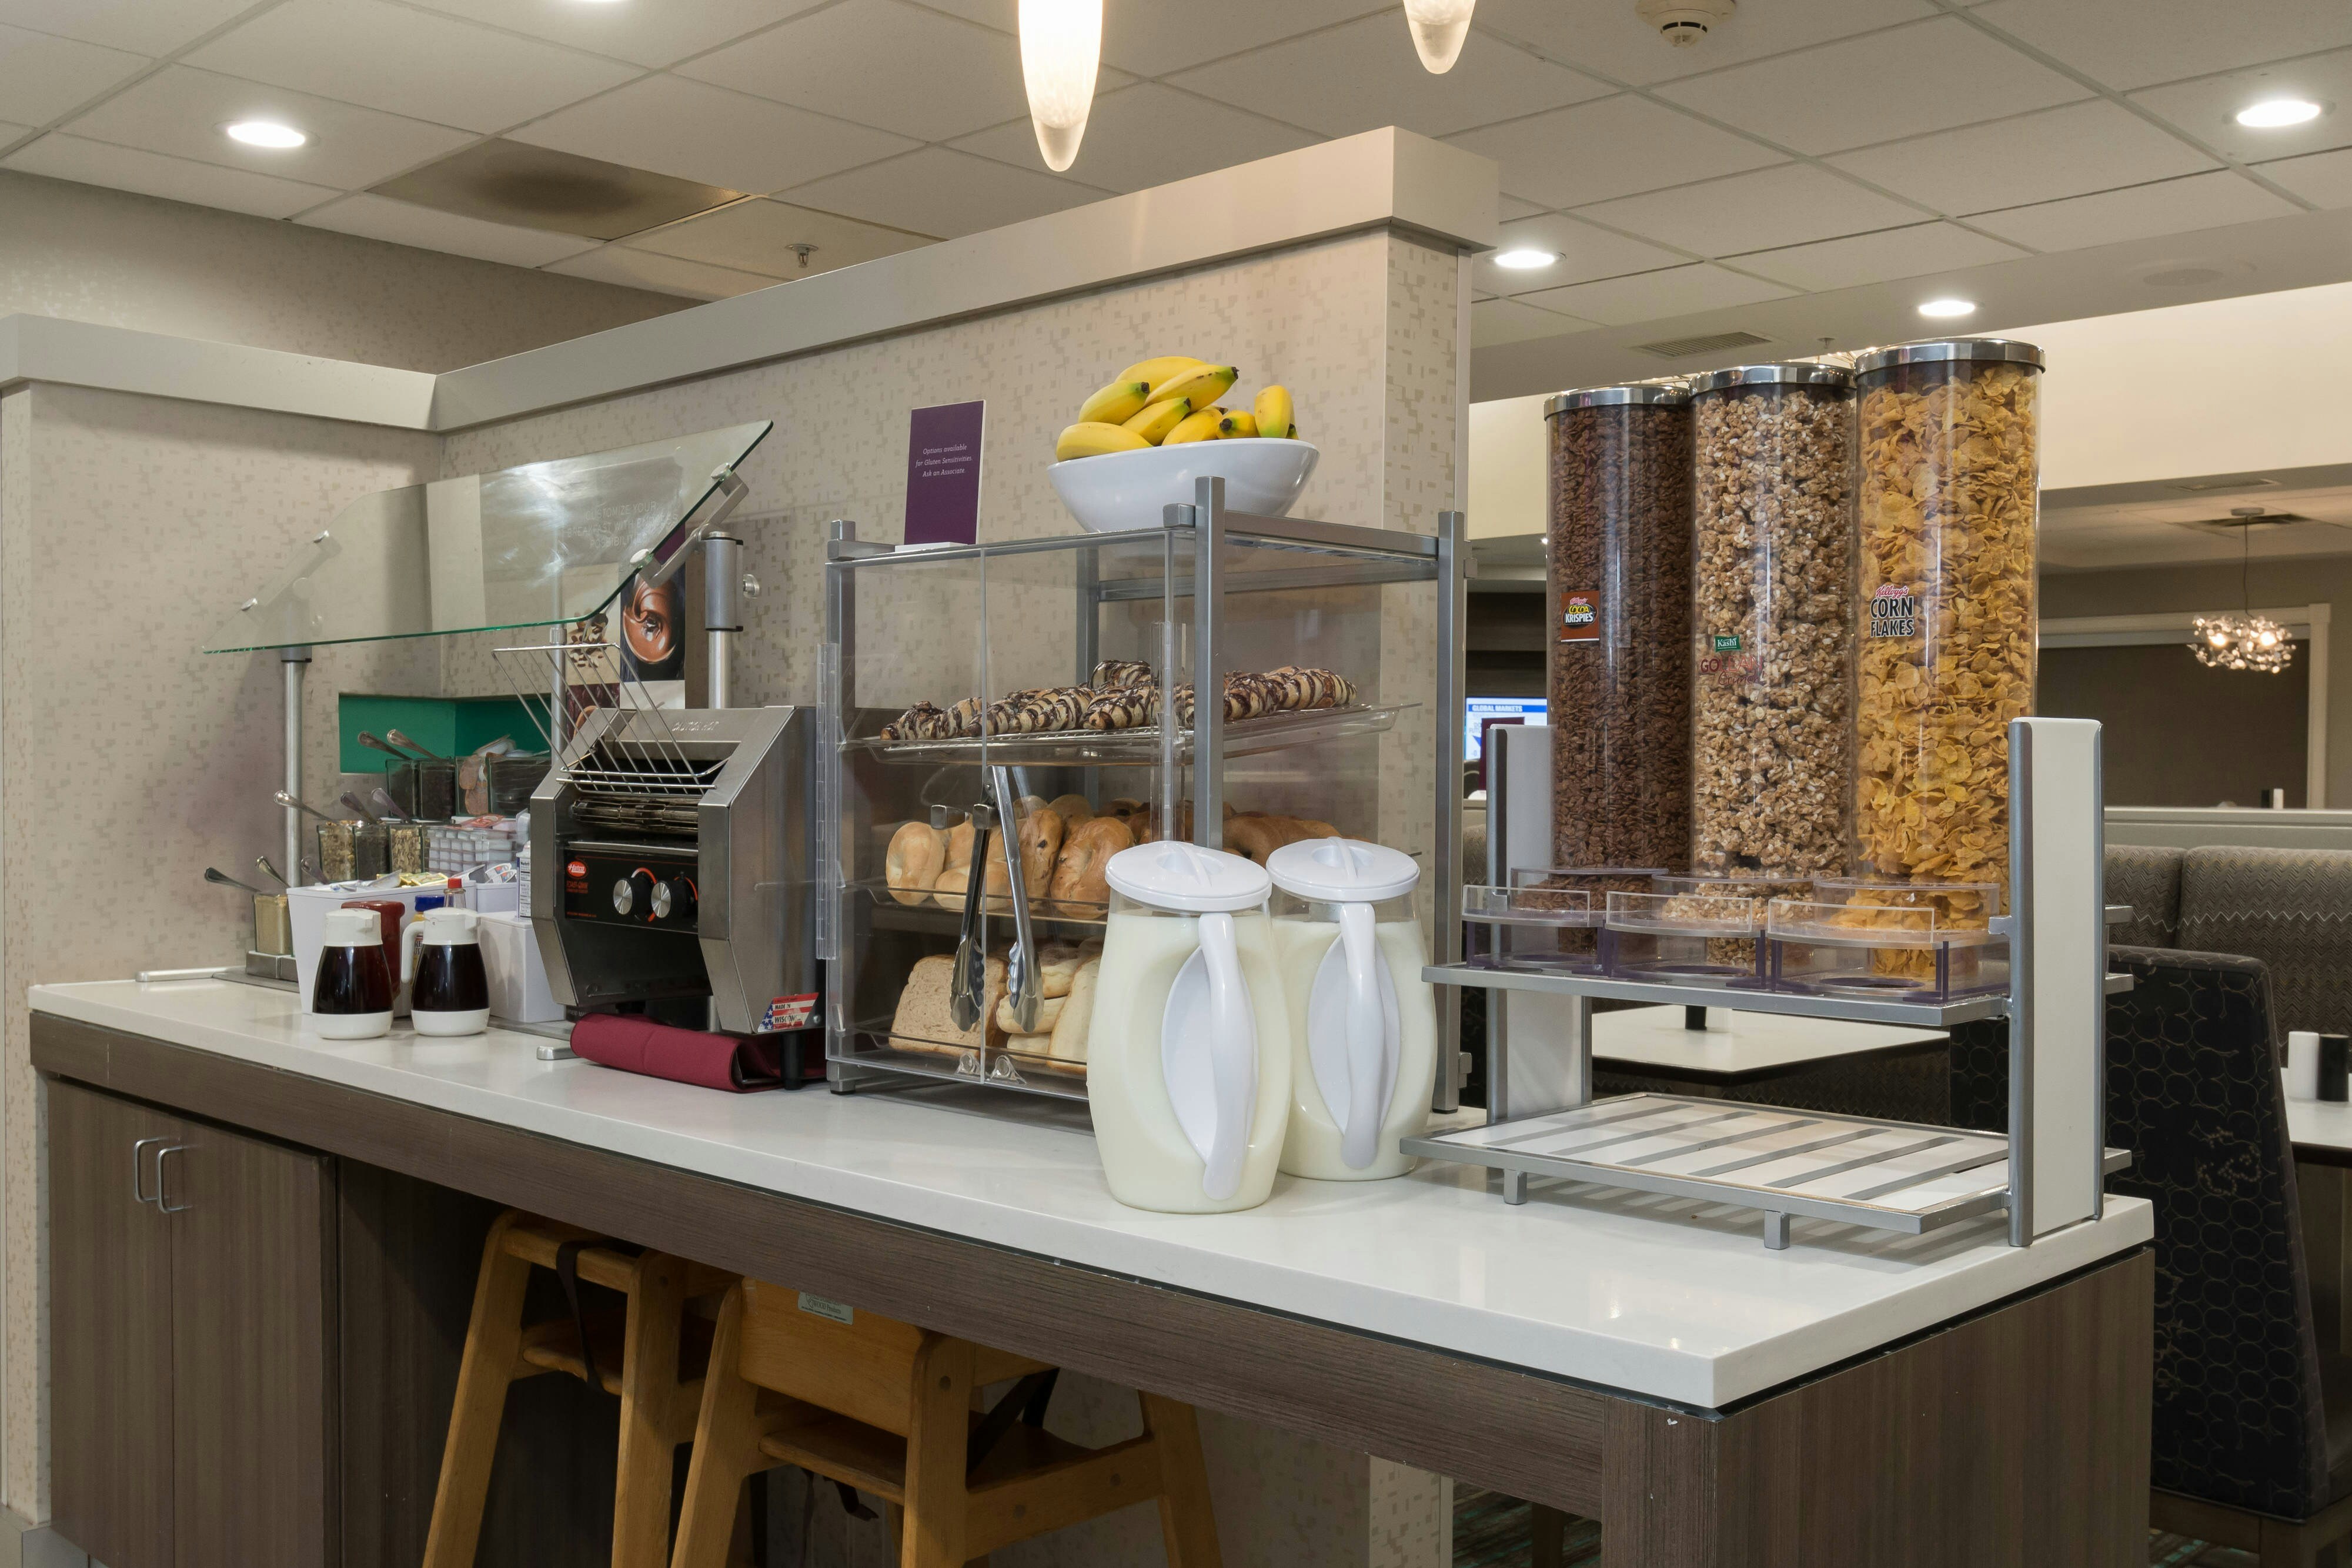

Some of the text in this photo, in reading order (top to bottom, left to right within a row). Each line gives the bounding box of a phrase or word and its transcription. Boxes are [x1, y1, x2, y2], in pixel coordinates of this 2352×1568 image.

[944, 443, 967, 452] available
[915, 460, 923, 468] for
[585, 501, 656, 520] CUSTOMIZE YOUR
[1876, 584, 1909, 599] Kellogg's
[1569, 605, 1590, 614] COCOA
[1870, 596, 1914, 618] CORN
[1565, 613, 1593, 623] KRISPIES
[1871, 619, 1914, 637] FLAKES
[1717, 637, 1737, 647] Kashi
[1700, 655, 1763, 673] GOLEAN
